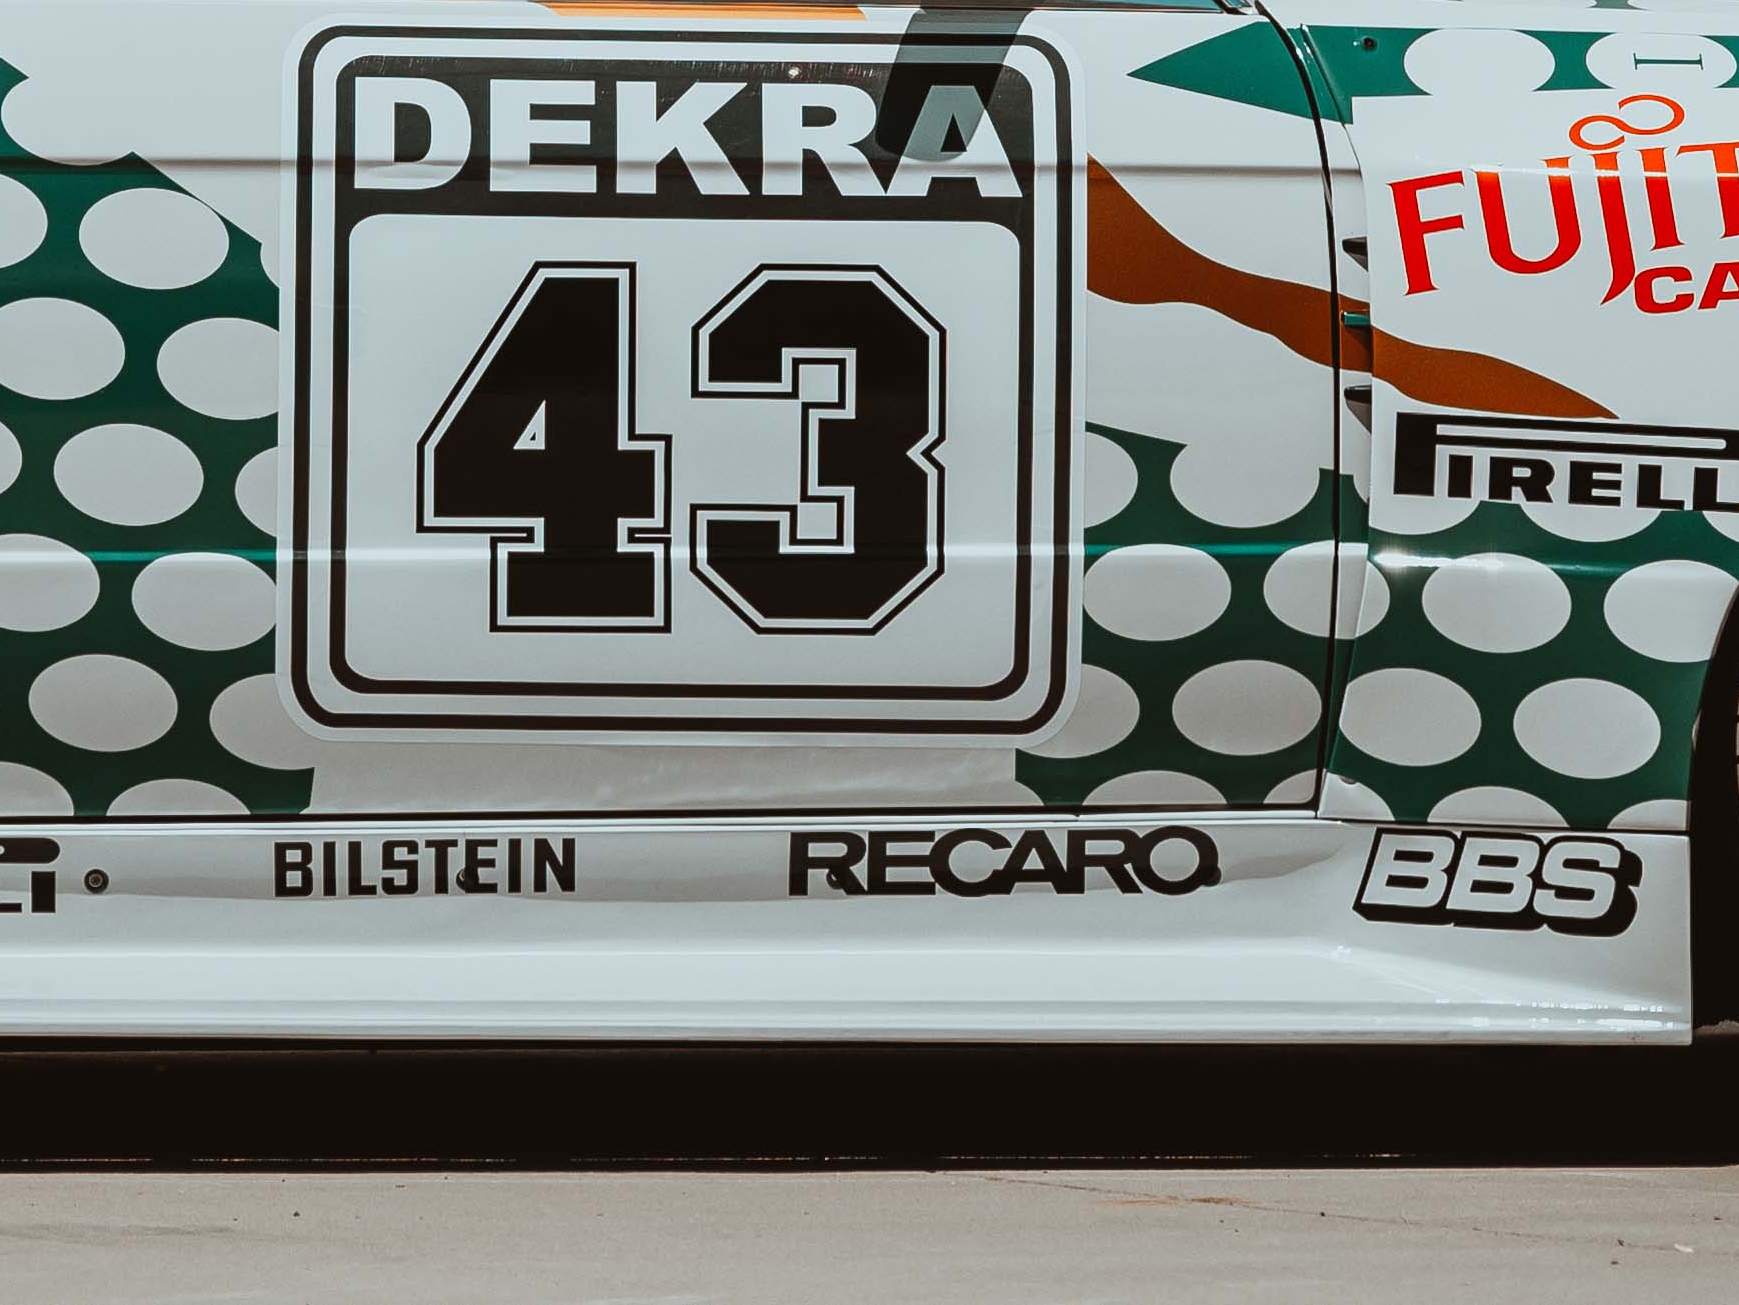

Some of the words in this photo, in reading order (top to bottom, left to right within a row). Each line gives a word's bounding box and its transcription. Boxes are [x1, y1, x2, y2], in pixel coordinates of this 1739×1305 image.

[354, 76, 1023, 198] DEKRA
[415, 261, 947, 636] 43
[273, 837, 577, 898] BILSTEIN
[788, 825, 1214, 898] RECARO
[1352, 827, 1643, 938] BBS
